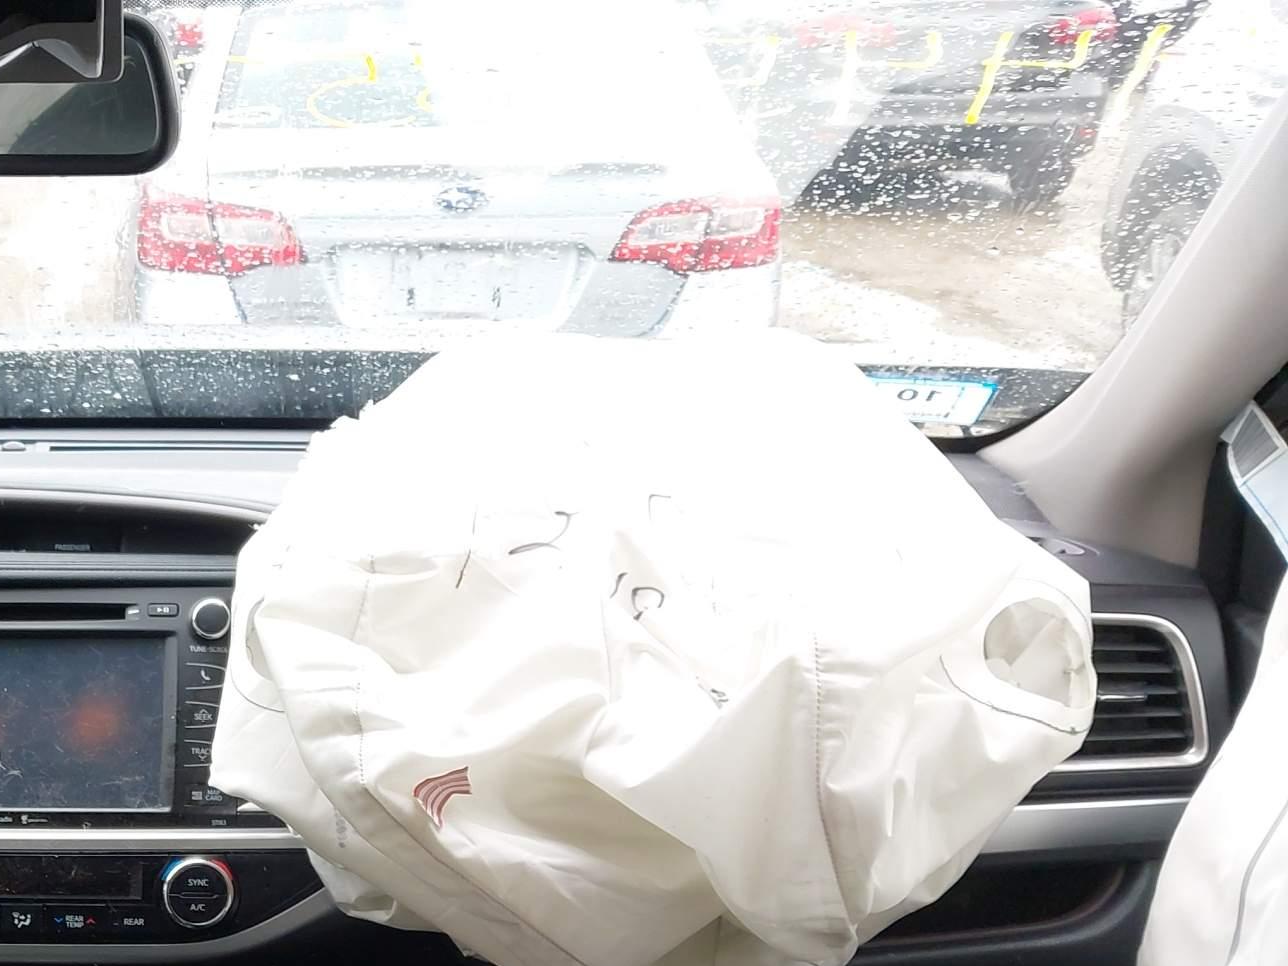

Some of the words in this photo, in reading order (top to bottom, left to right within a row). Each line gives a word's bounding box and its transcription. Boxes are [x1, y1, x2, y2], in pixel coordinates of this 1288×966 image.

[193, 713, 213, 721] SEEK
[191, 747, 212, 755] TRAC
[187, 879, 209, 887] SYNC
[190, 904, 206, 912] A/C
[123, 918, 145, 926] REAR
